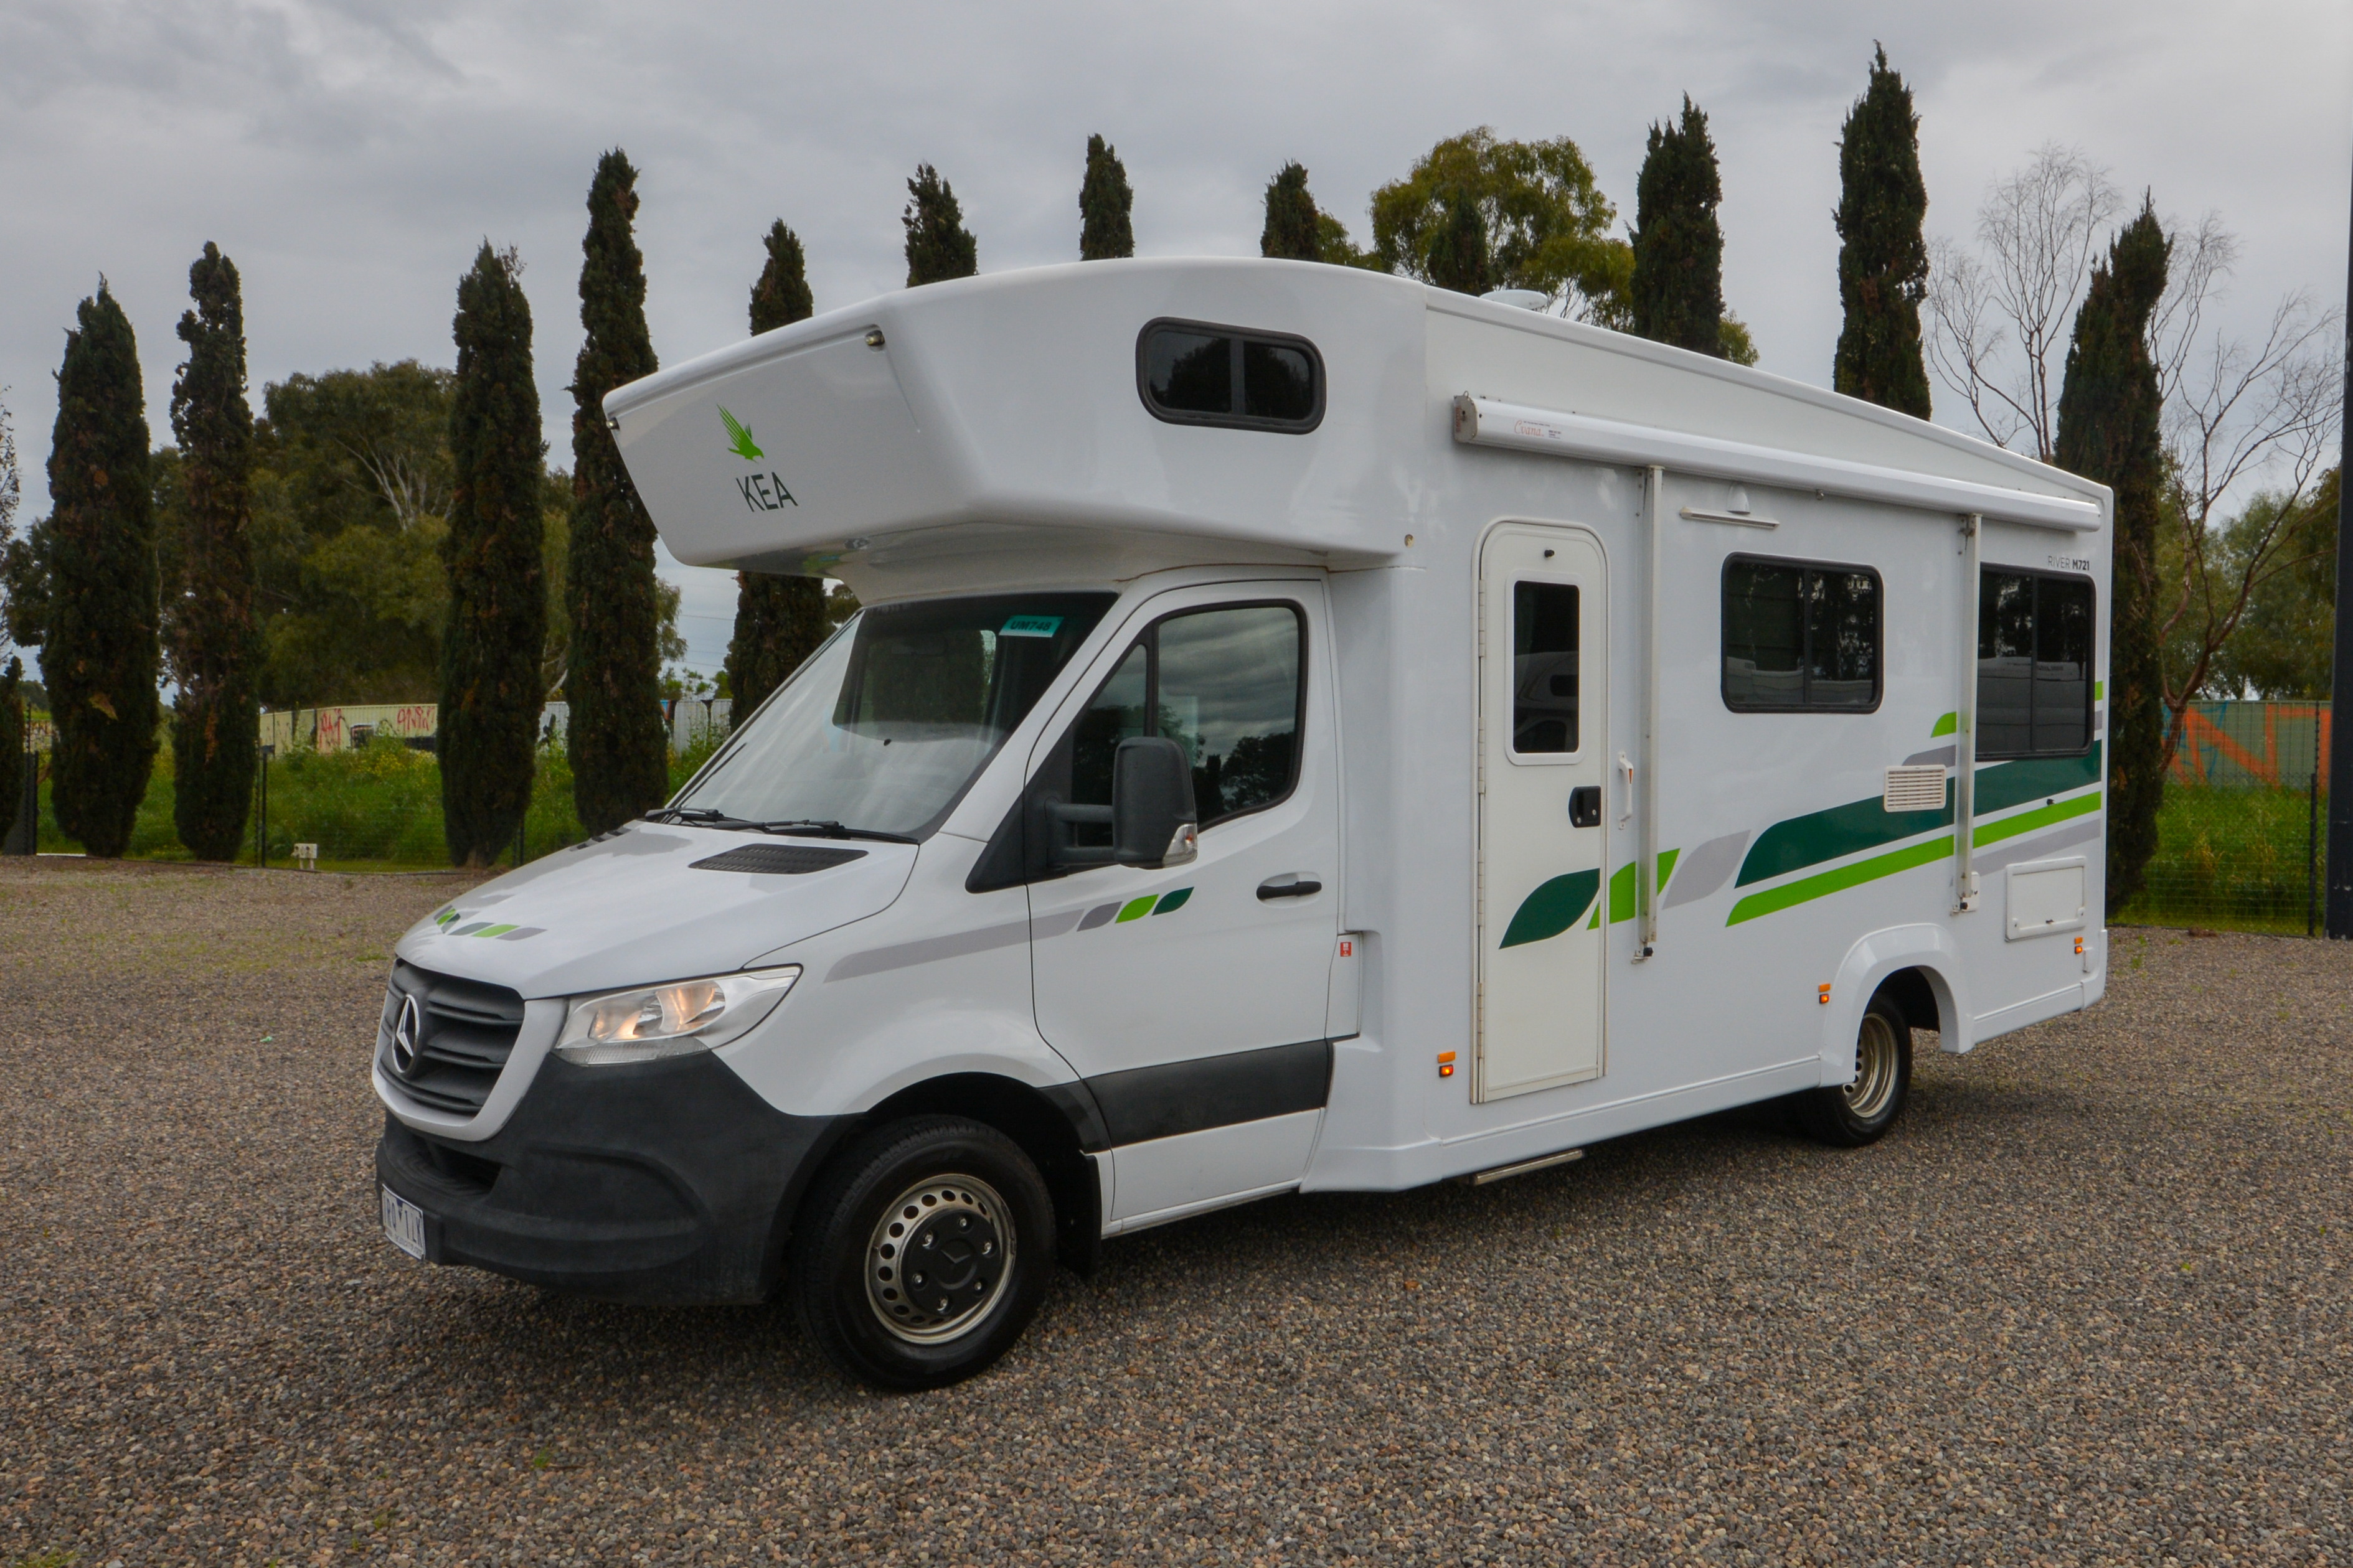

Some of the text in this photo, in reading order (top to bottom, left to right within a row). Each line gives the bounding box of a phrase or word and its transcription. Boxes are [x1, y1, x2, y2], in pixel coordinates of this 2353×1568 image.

[735, 472, 798, 512] KEA
[2048, 556, 2090, 571] RIVER M721
[1010, 621, 1052, 631] UM748
